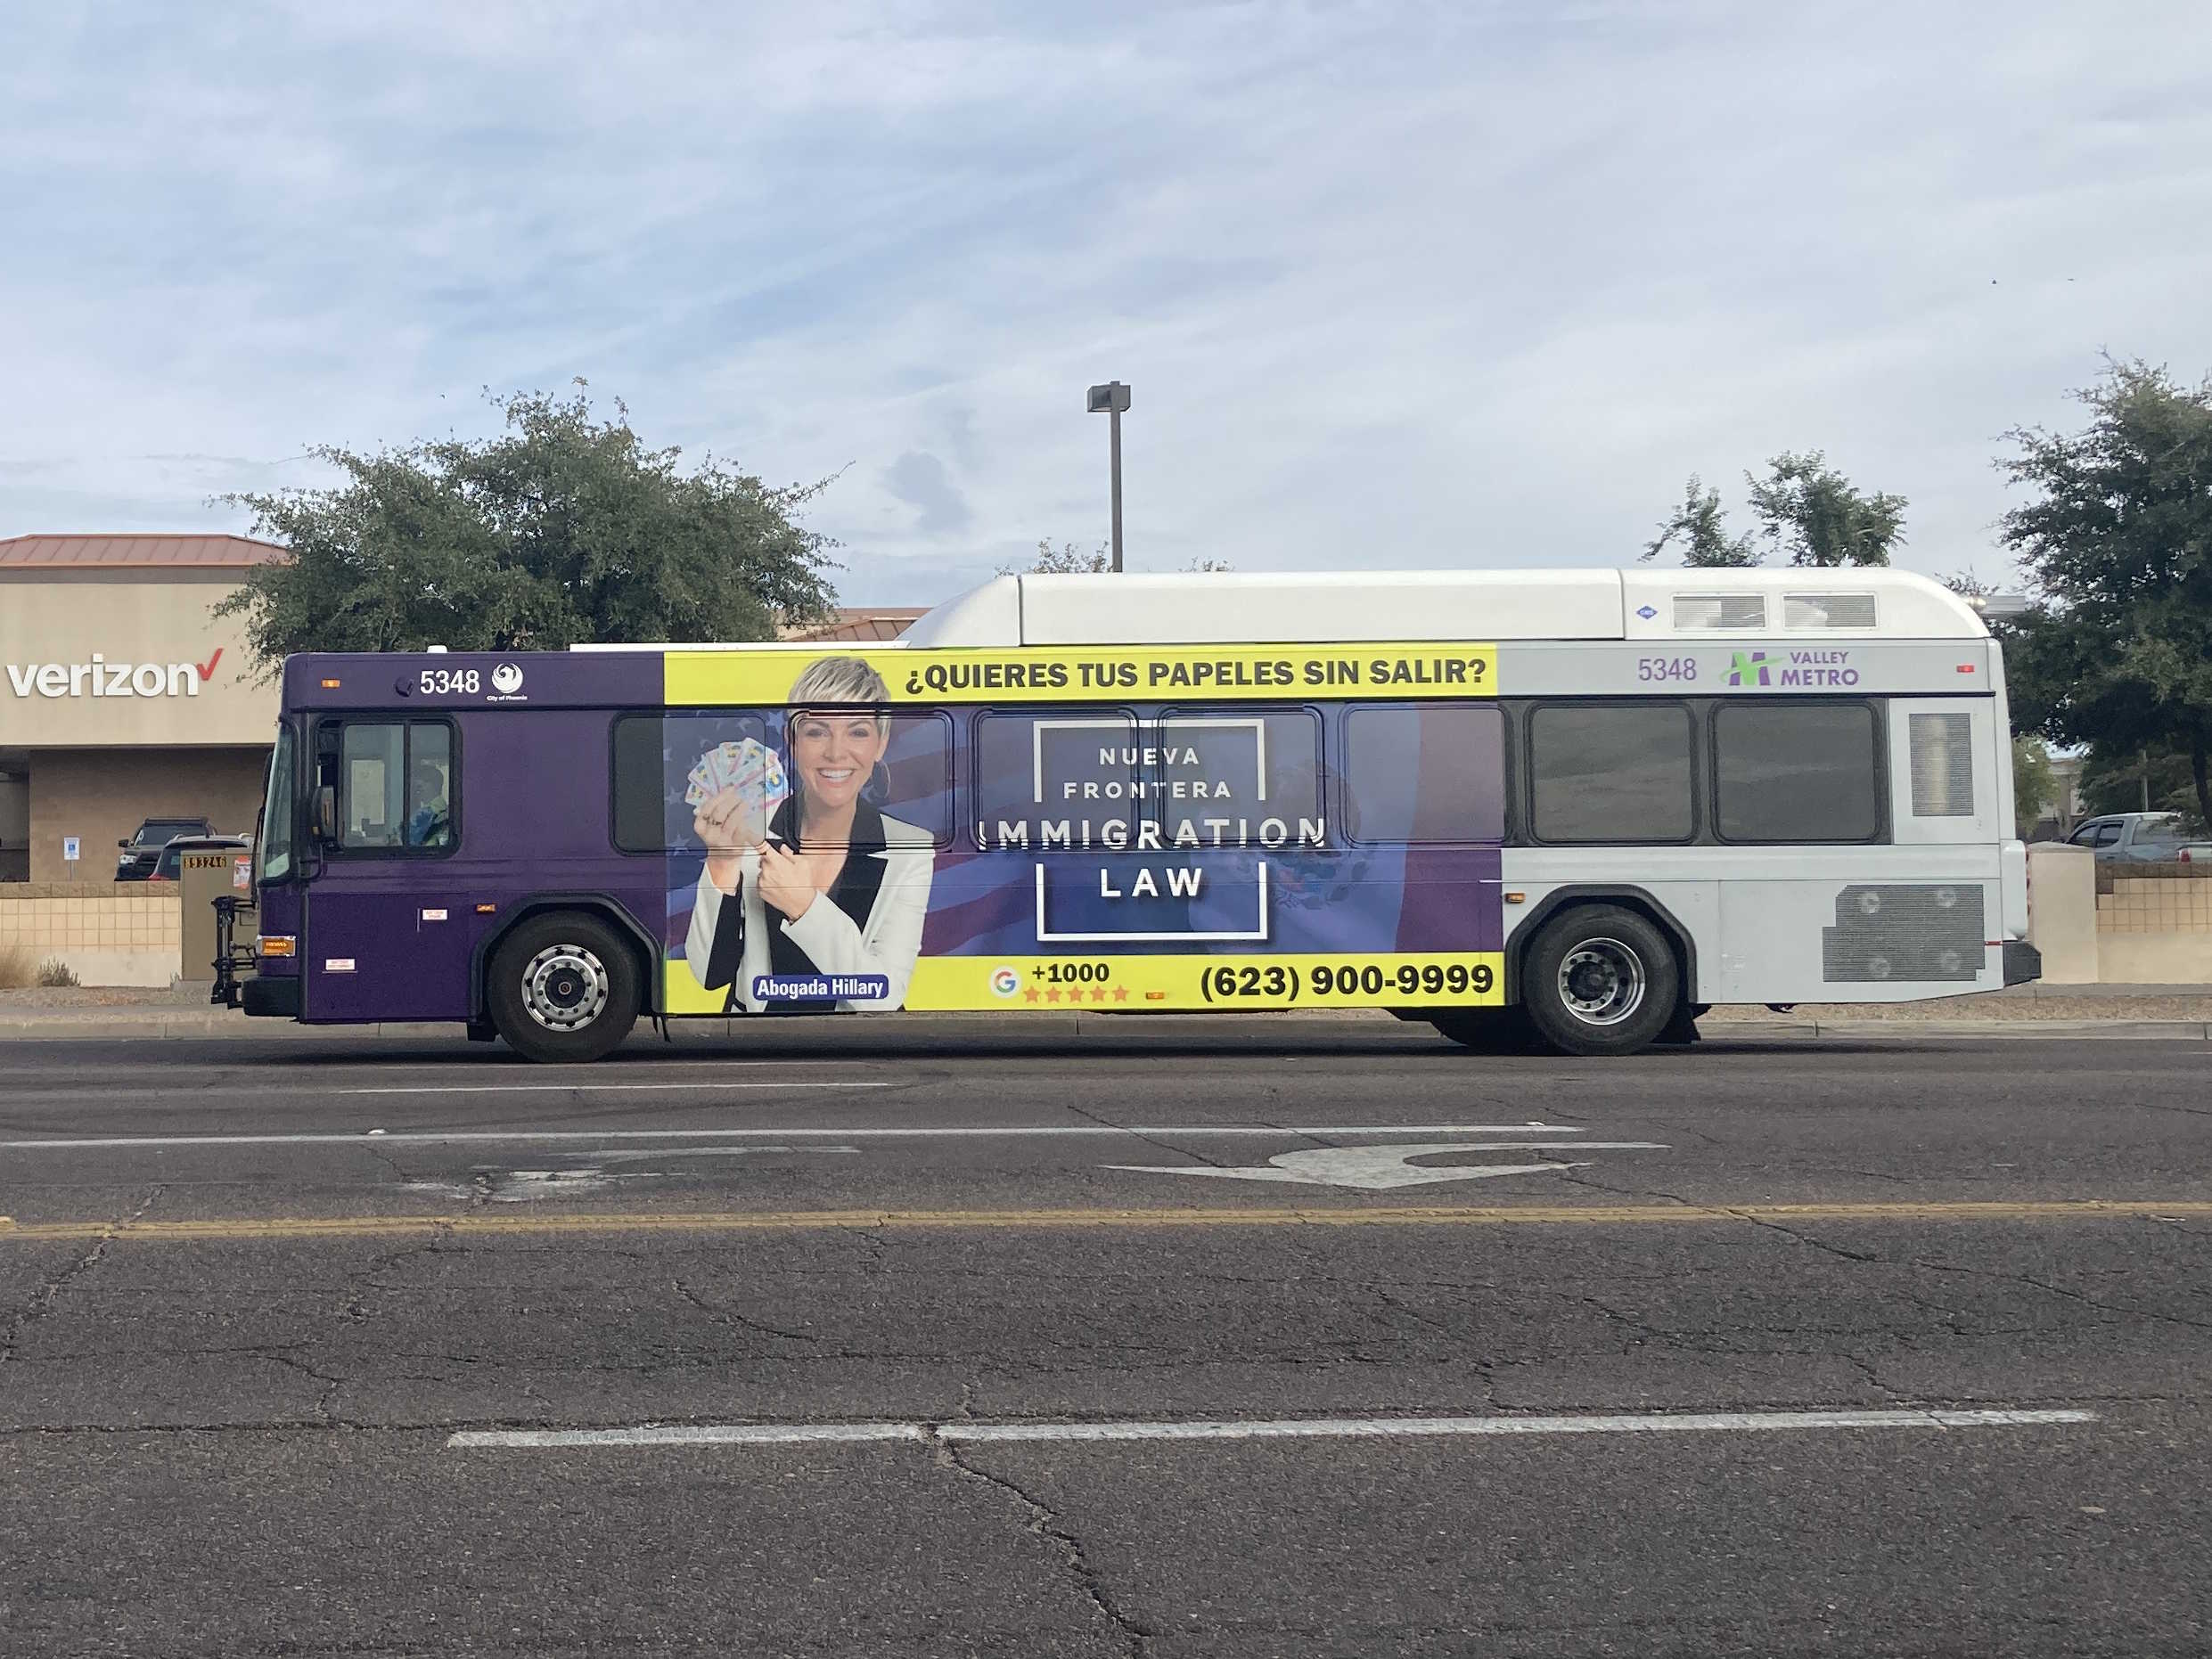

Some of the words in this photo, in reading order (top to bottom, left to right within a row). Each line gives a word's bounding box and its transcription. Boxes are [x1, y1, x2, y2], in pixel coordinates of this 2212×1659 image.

[1638, 658, 1698, 682] 5348
[1789, 651, 1849, 665] VALLEY
[6, 653, 200, 698] verizon
[420, 669, 480, 694] 5348
[905, 663, 1068, 694] ¿QUIERES
[1077, 662, 1138, 687] TUS
[1149, 661, 1292, 687] PAPELES
[1303, 659, 1359, 685] SIN
[1369, 658, 1486, 685] SALIR?
[1780, 668, 1860, 686] METRO
[1099, 747, 1199, 766] NUEVA
[1062, 780, 1232, 799] FRONTERA
[978, 817, 1326, 850] IMMIGRATION
[1100, 867, 1202, 898] LAW
[1032, 962, 1110, 983] +1000
[1200, 966, 1299, 1002] (623)
[1311, 964, 1494, 995] 900-9999
[757, 978, 829, 1001] Abogada
[831, 977, 885, 999] Hillary
